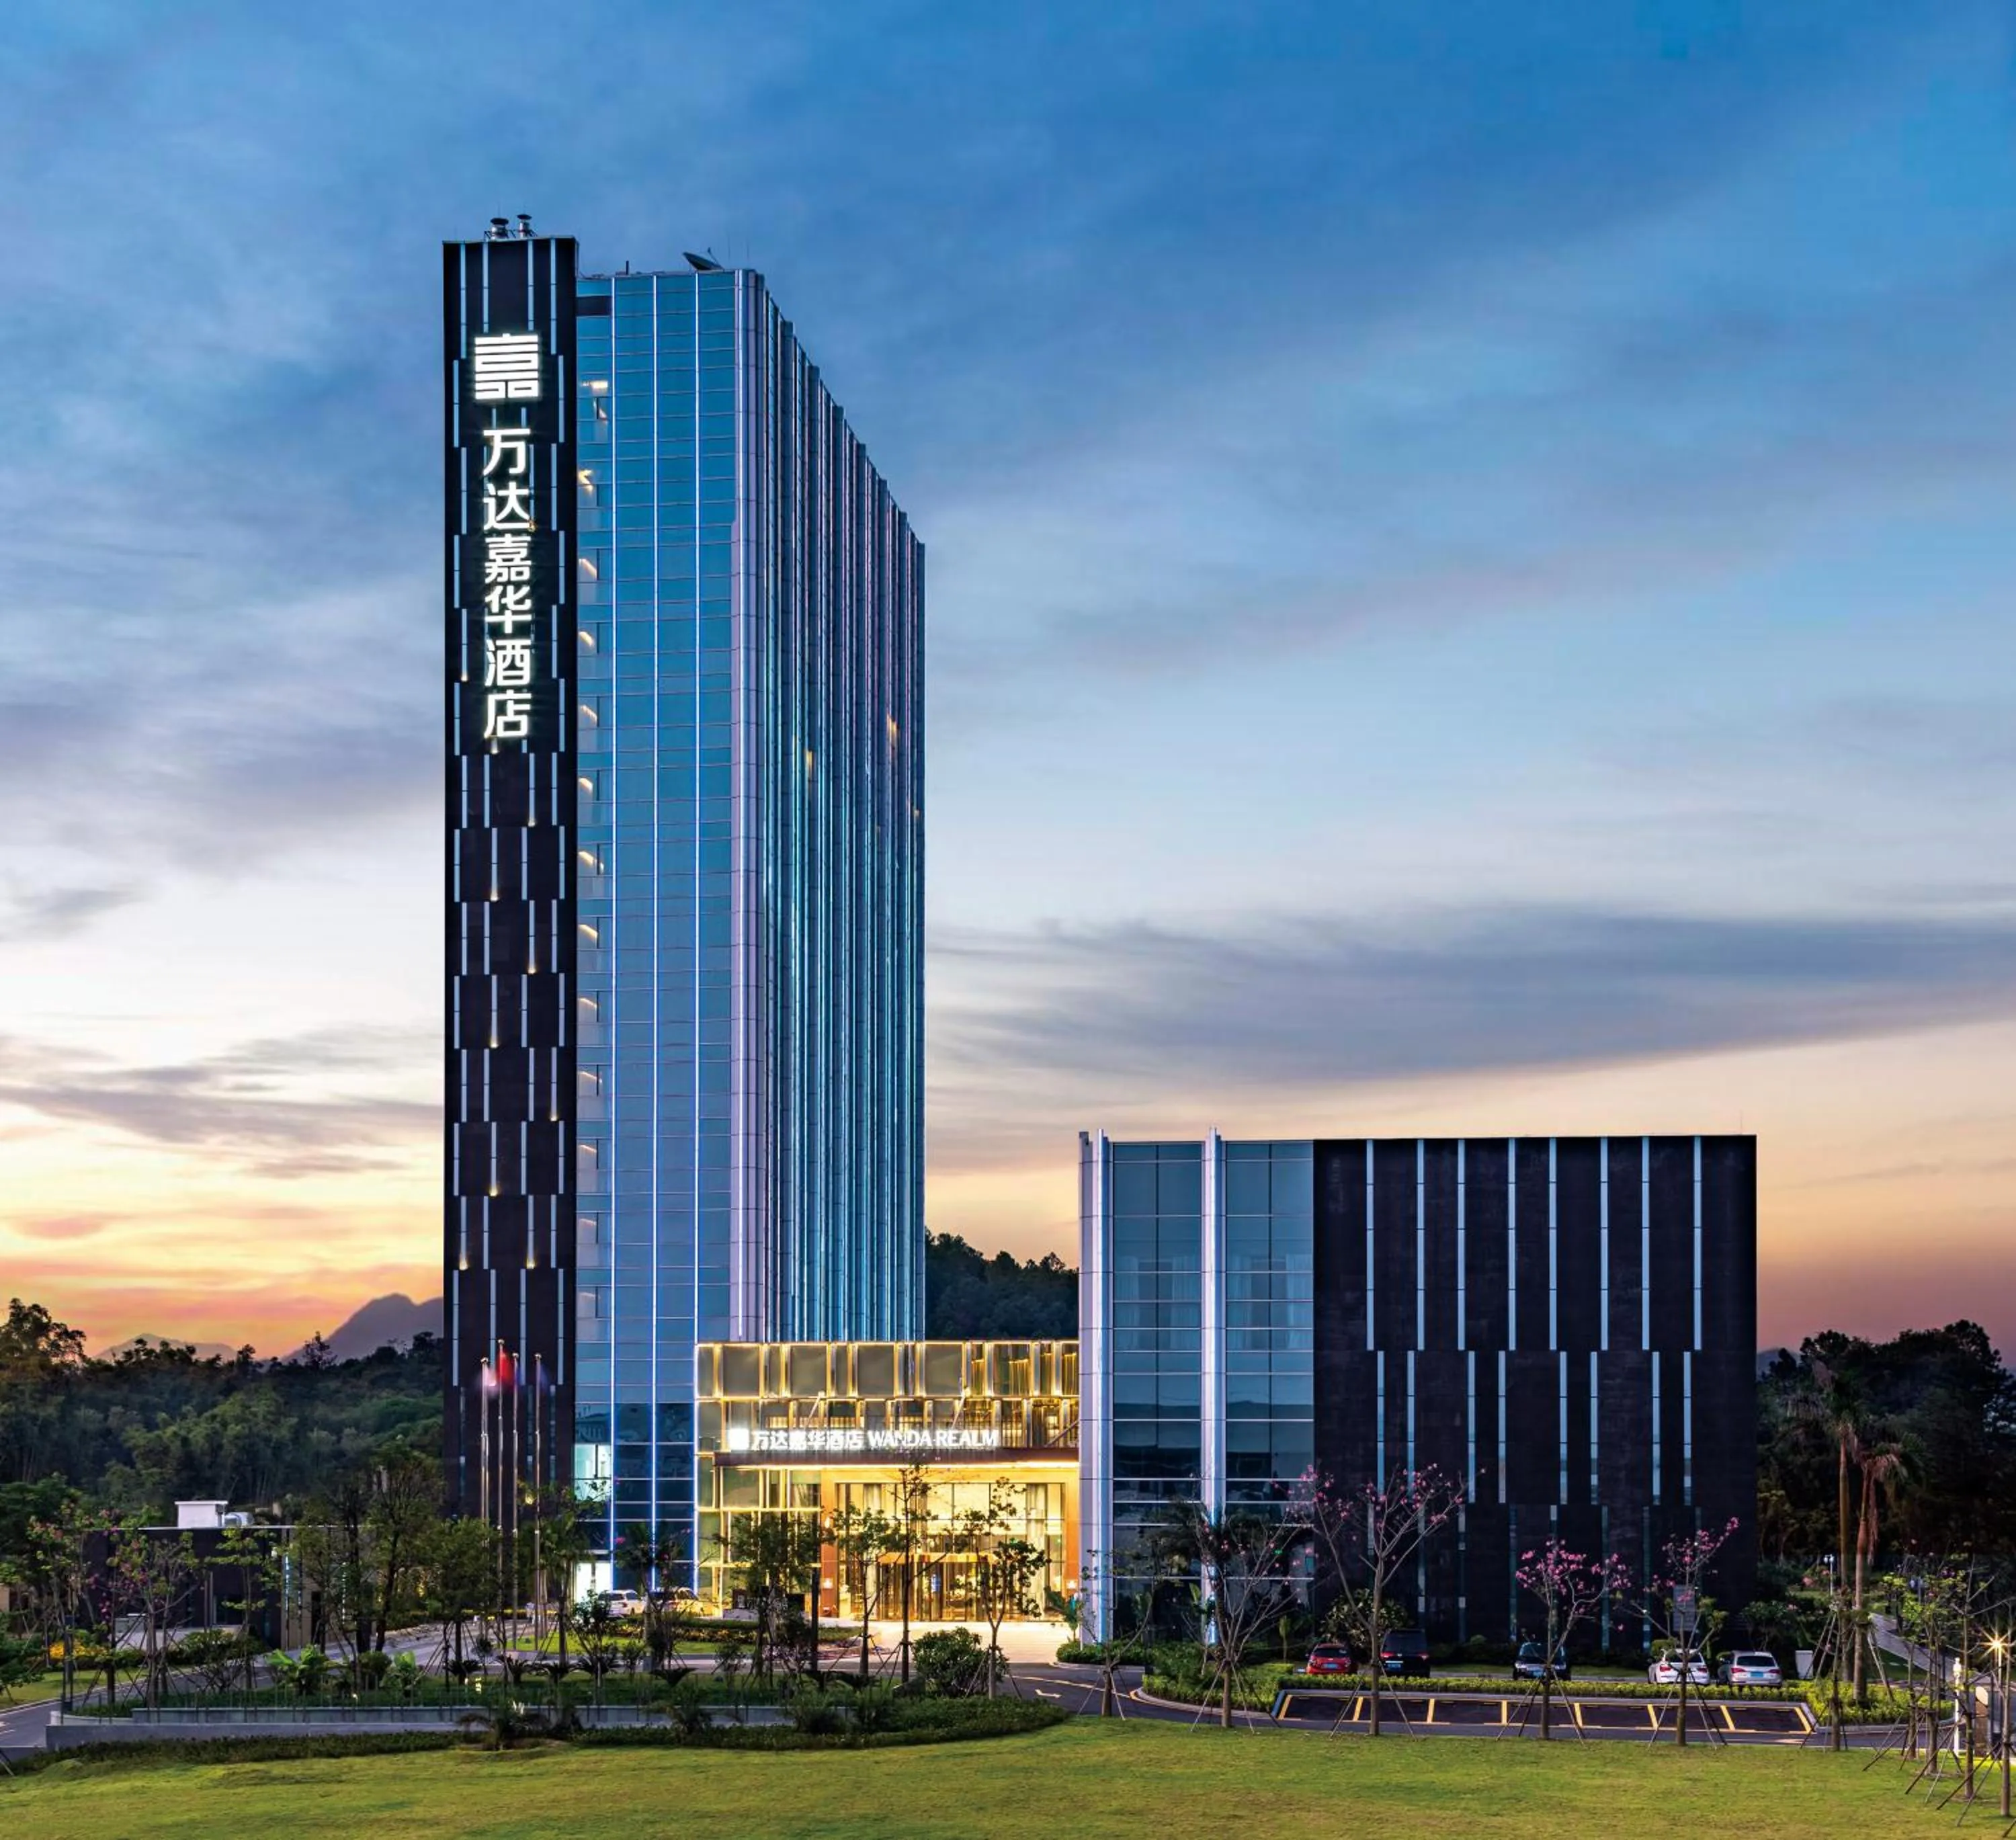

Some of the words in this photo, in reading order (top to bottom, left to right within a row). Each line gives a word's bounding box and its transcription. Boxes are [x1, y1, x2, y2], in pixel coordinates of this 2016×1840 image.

[483, 429, 532, 739] 万达嘉华酒店
[867, 1429, 932, 1447] WANDA
[935, 1429, 999, 1447] REALM
